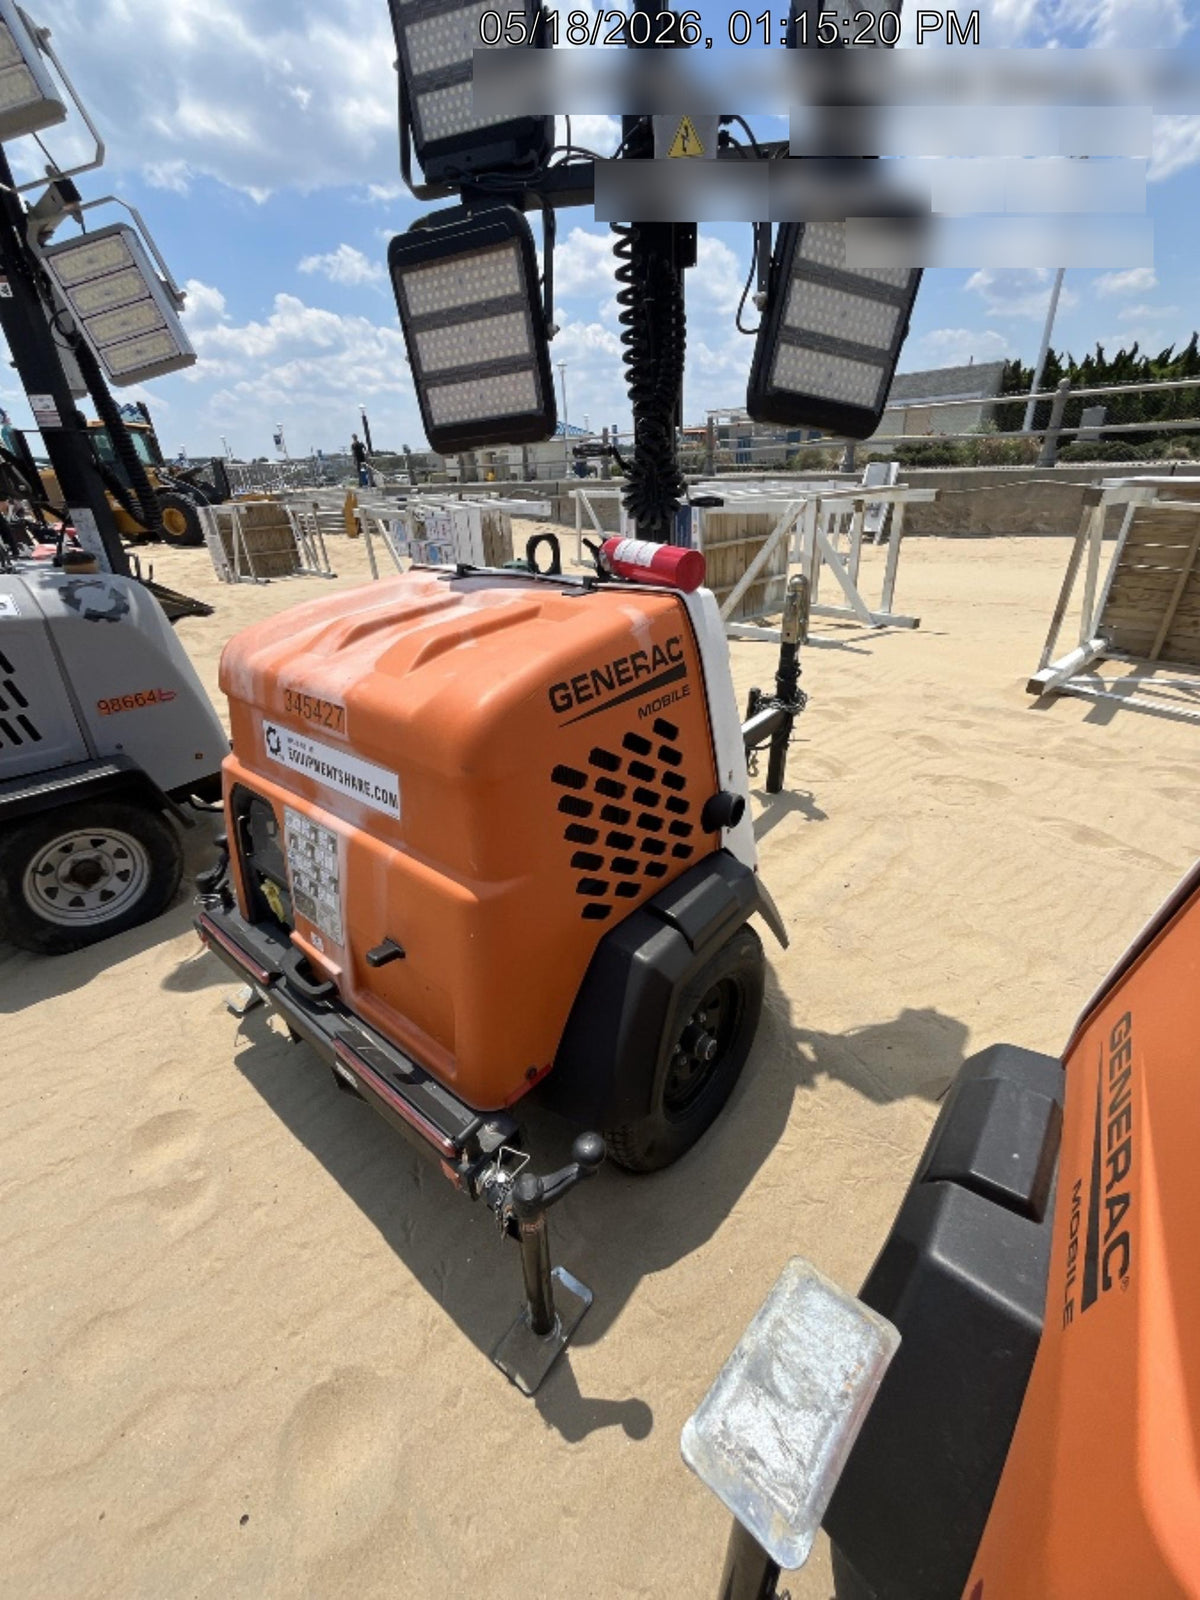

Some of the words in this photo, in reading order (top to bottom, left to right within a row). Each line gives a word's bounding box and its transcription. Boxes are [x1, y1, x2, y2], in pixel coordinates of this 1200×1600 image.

[549, 636, 684, 713] GENERAC
[637, 684, 691, 720] MOBILE
[284, 688, 346, 734] 345427
[287, 746, 399, 810] EQUIPMENTSHARE.COM
[1101, 1010, 1132, 1292] GENERAC
[1062, 1178, 1083, 1331] MOBILE
